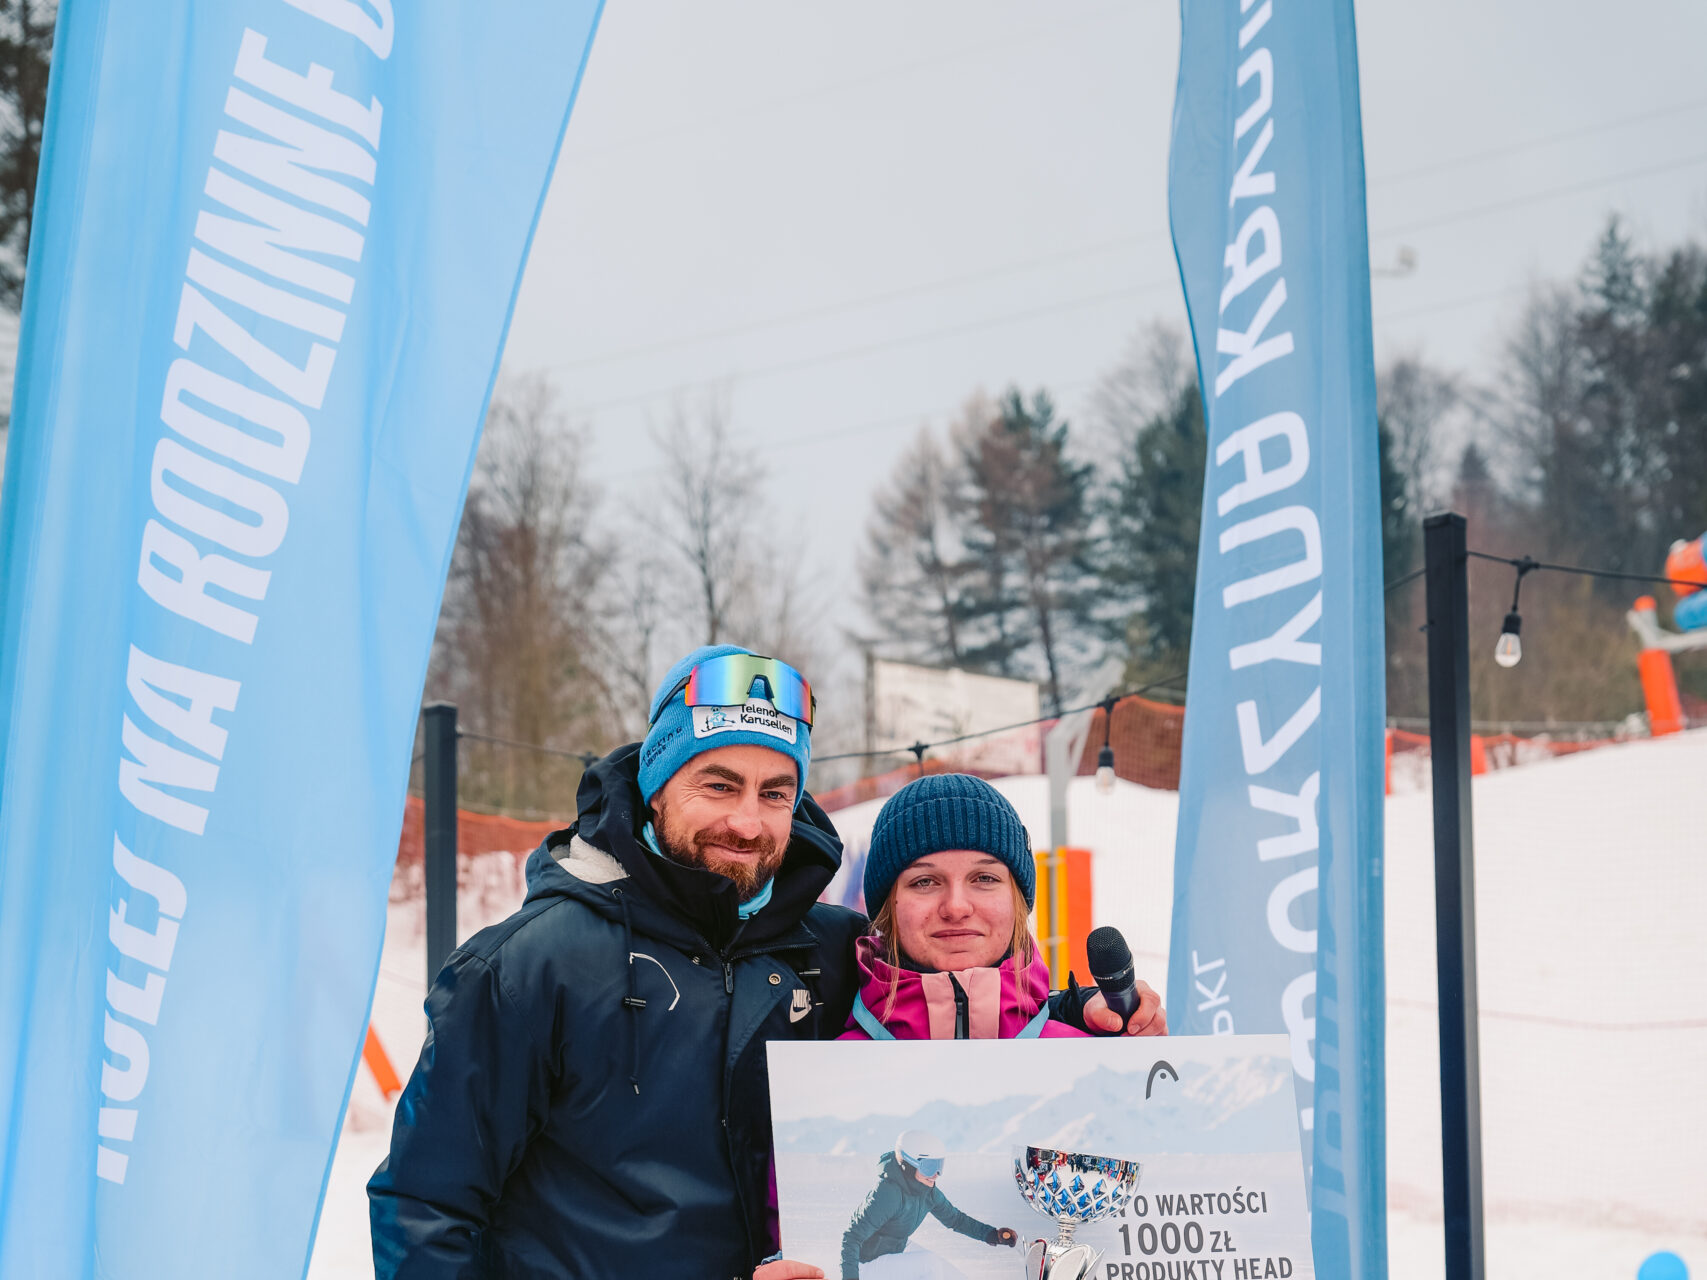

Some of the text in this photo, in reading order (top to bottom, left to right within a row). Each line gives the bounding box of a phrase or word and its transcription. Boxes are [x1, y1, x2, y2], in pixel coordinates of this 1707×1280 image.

[137, 27, 383, 645] RODZINNE
[740, 704, 779, 718] Telenor
[740, 714, 793, 736] Karusellen
[119, 644, 241, 835] NA
[1134, 1195, 1148, 1217] O
[1155, 1186, 1267, 1217] WARTOŚCI
[1119, 1221, 1204, 1256] 1000
[1234, 1257, 1293, 1280] HEAD
